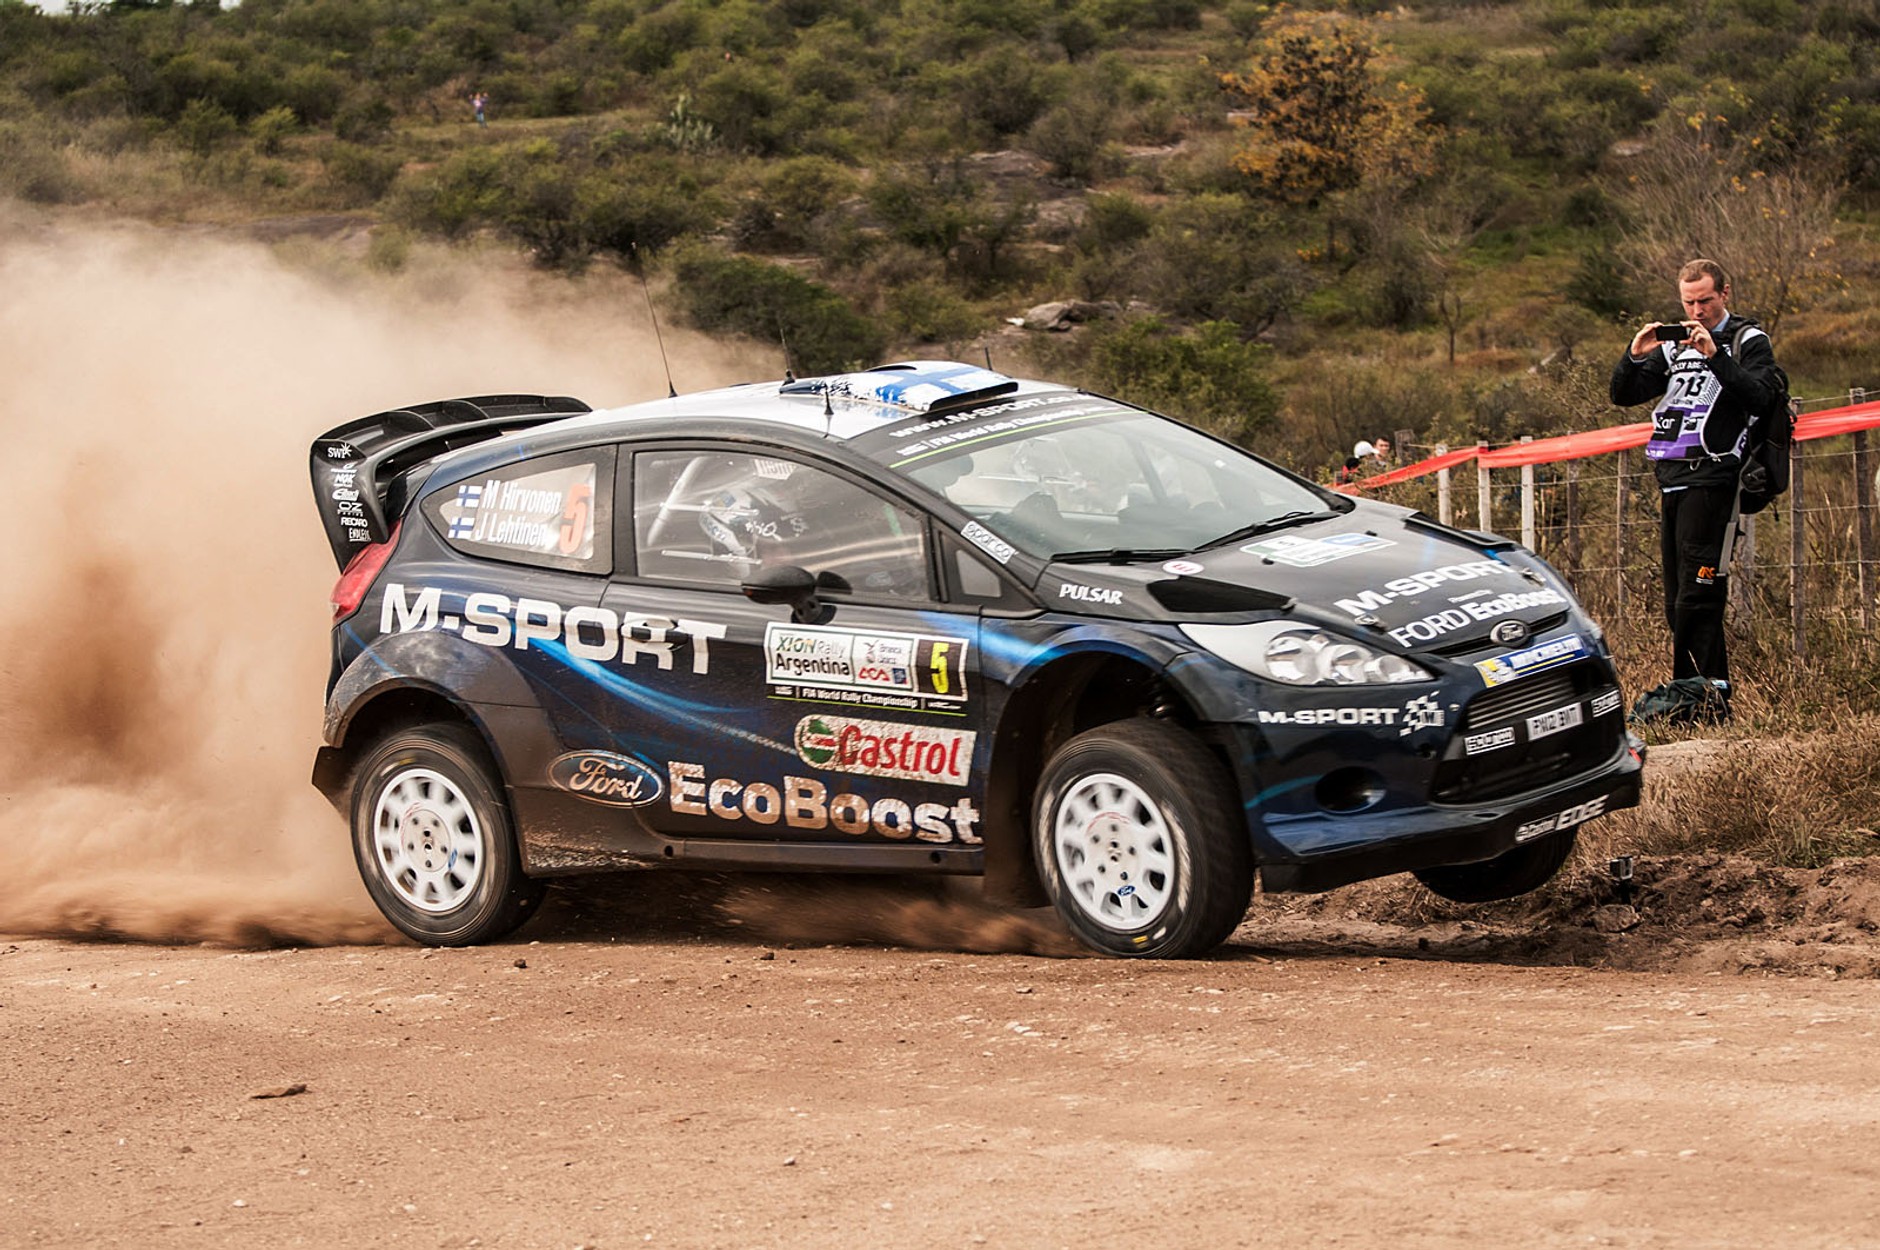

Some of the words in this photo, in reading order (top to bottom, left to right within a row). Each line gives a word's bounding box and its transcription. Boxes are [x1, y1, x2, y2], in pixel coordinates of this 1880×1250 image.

[482, 479, 501, 509] M
[499, 480, 562, 514] Hirvonen
[559, 483, 591, 554] 5
[487, 511, 549, 547] Lehtinen
[1059, 583, 1124, 605] PULSAR
[1333, 560, 1518, 616] M-SPORT
[379, 583, 728, 675] M-SPORT
[1388, 609, 1472, 648] FORD
[1460, 588, 1567, 621] EcoBoost
[775, 652, 850, 676] Argentina
[930, 642, 949, 693] 5
[802, 688, 817, 698] FIA
[817, 689, 841, 700] World
[841, 691, 861, 704] Rally
[862, 693, 918, 709] Championship
[1258, 708, 1399, 725] M-SPORT
[838, 724, 962, 777] Castrol
[569, 756, 644, 801] Ford
[668, 761, 985, 845] EcoBoost
